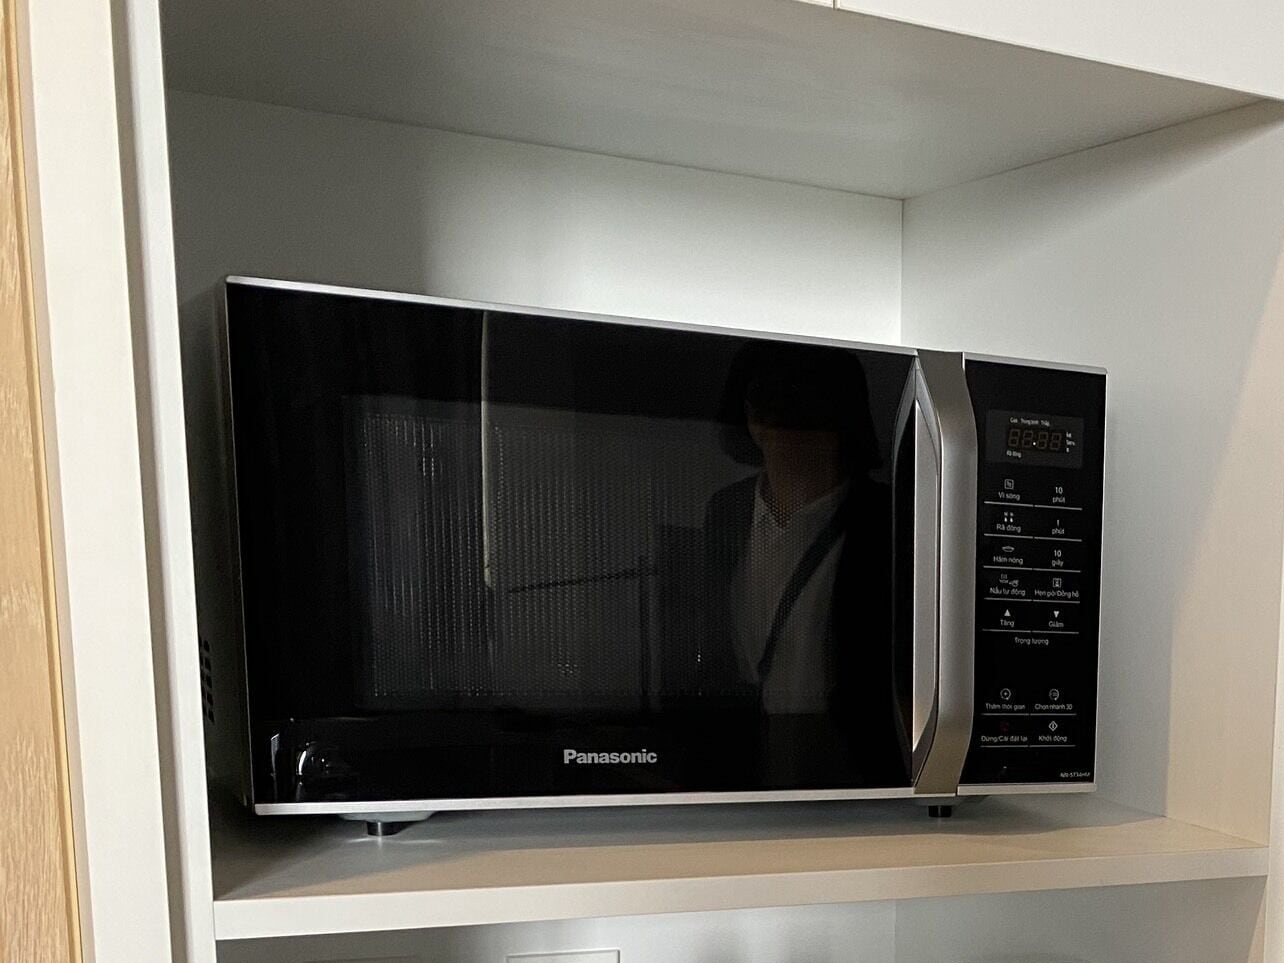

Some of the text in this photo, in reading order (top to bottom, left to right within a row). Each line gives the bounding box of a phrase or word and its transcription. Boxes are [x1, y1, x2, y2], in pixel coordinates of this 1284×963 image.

[1055, 486, 1063, 494] 10
[1054, 549, 1061, 557] 10
[563, 748, 658, 764] Panasonic
